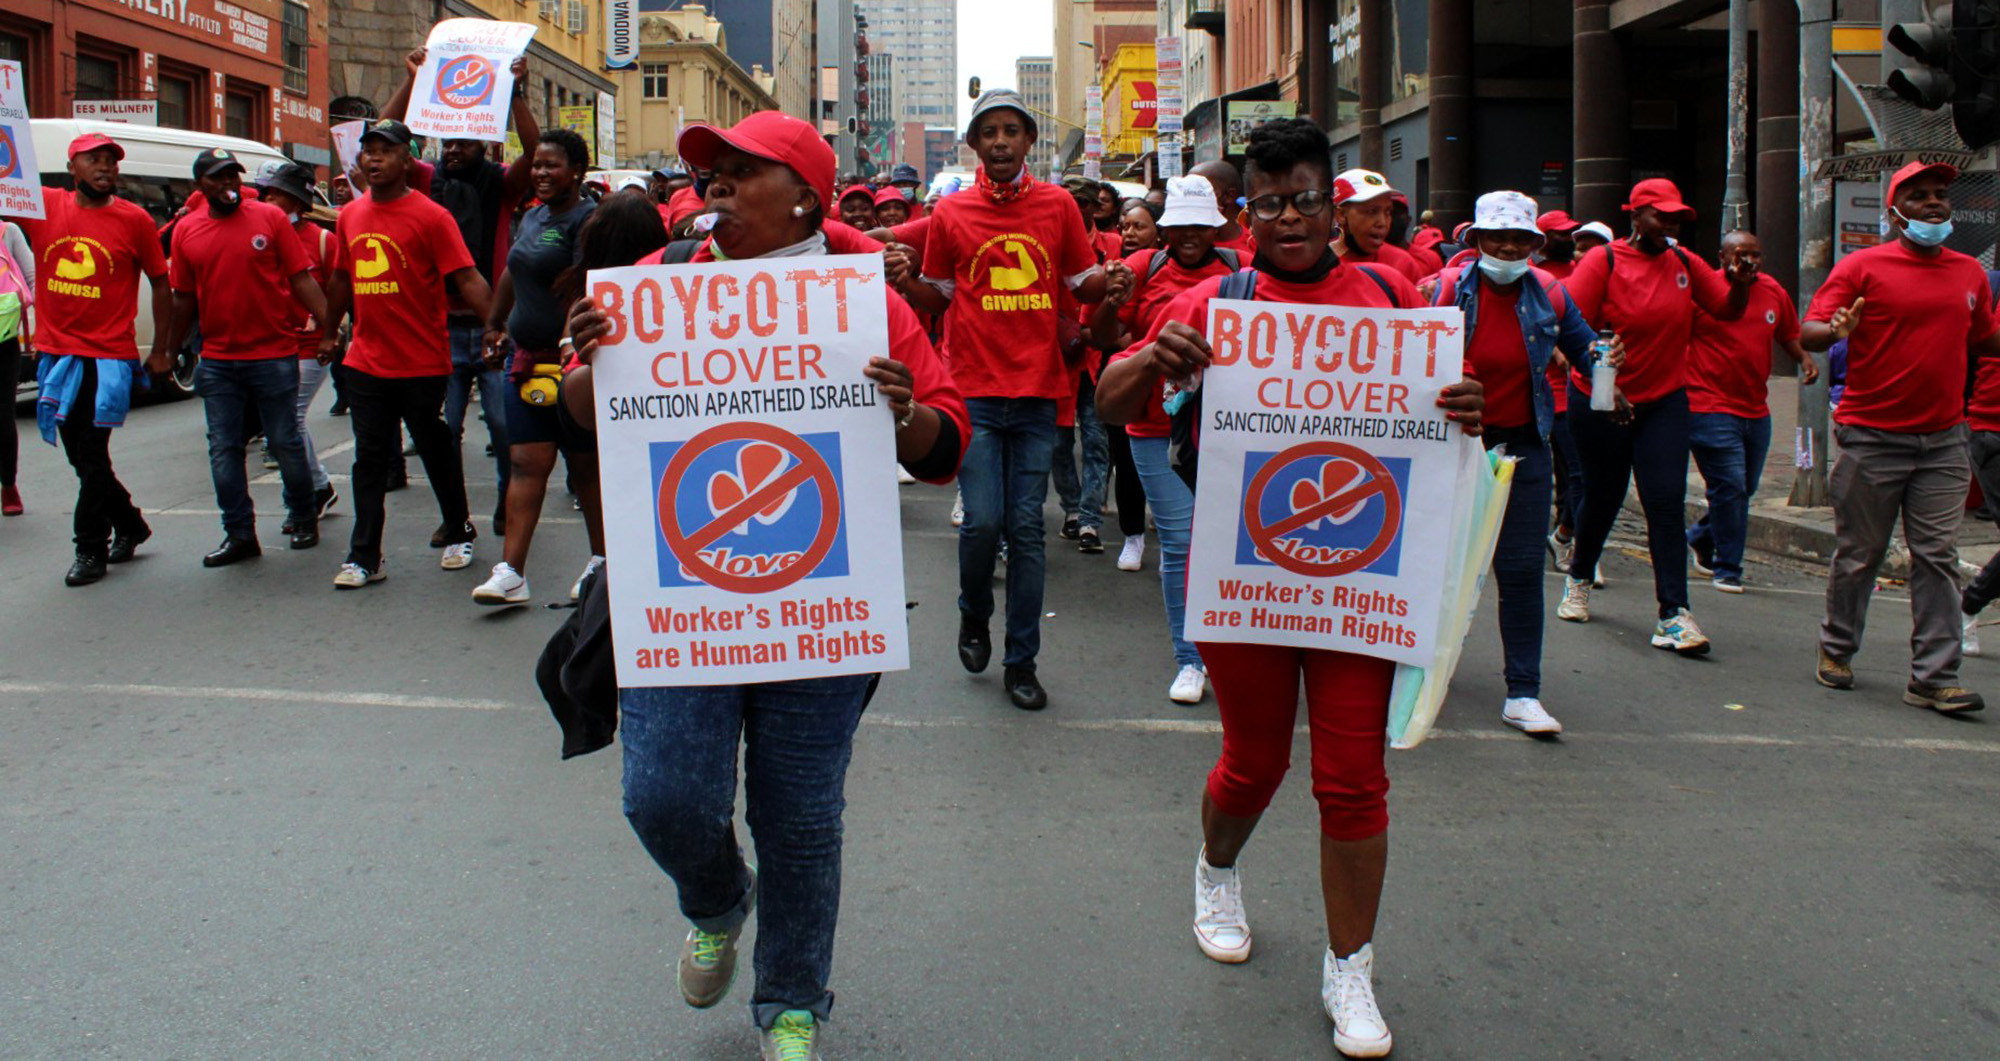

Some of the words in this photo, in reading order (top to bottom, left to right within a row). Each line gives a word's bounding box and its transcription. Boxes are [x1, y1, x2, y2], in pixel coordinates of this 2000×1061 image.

[614, 1, 630, 56] WOODWA
[100, 104, 154, 114] MILLINERY
[421, 108, 462, 121] Worker's
[465, 111, 495, 123] Rights
[412, 120, 430, 130] are
[432, 121, 464, 132] Human
[467, 123, 498, 135] Rights
[1824, 153, 1904, 176] ALBERTINA
[1918, 152, 1973, 171] SISULU
[0, 183, 31, 198] Rights
[6, 197, 37, 212] Rights
[48, 278, 101, 299] GIWUSA
[354, 281, 399, 295] IWUSA
[982, 292, 1052, 312] GIWUSA
[592, 267, 877, 347] BOYCOTT
[1210, 308, 1460, 378] BOYCOTT
[651, 343, 827, 388] CLOVER
[609, 393, 699, 421] SANCTION
[704, 386, 805, 416] APARTHEID
[809, 382, 876, 410] ISRAELI
[1257, 376, 1410, 414] CLOVER
[1214, 410, 1296, 434] SANCTION
[1300, 414, 1389, 439] APARTHEID
[1391, 419, 1449, 442] ISRAELI
[645, 602, 771, 635] Worker's
[780, 596, 870, 631] Rights
[1218, 579, 1325, 606] Worker's
[1332, 585, 1409, 617] Rights
[1203, 609, 1242, 627] are
[1250, 607, 1333, 634] Human
[1341, 614, 1418, 649] Rights
[635, 645, 681, 669] are
[690, 639, 788, 668] Human
[797, 629, 887, 663] Rights
